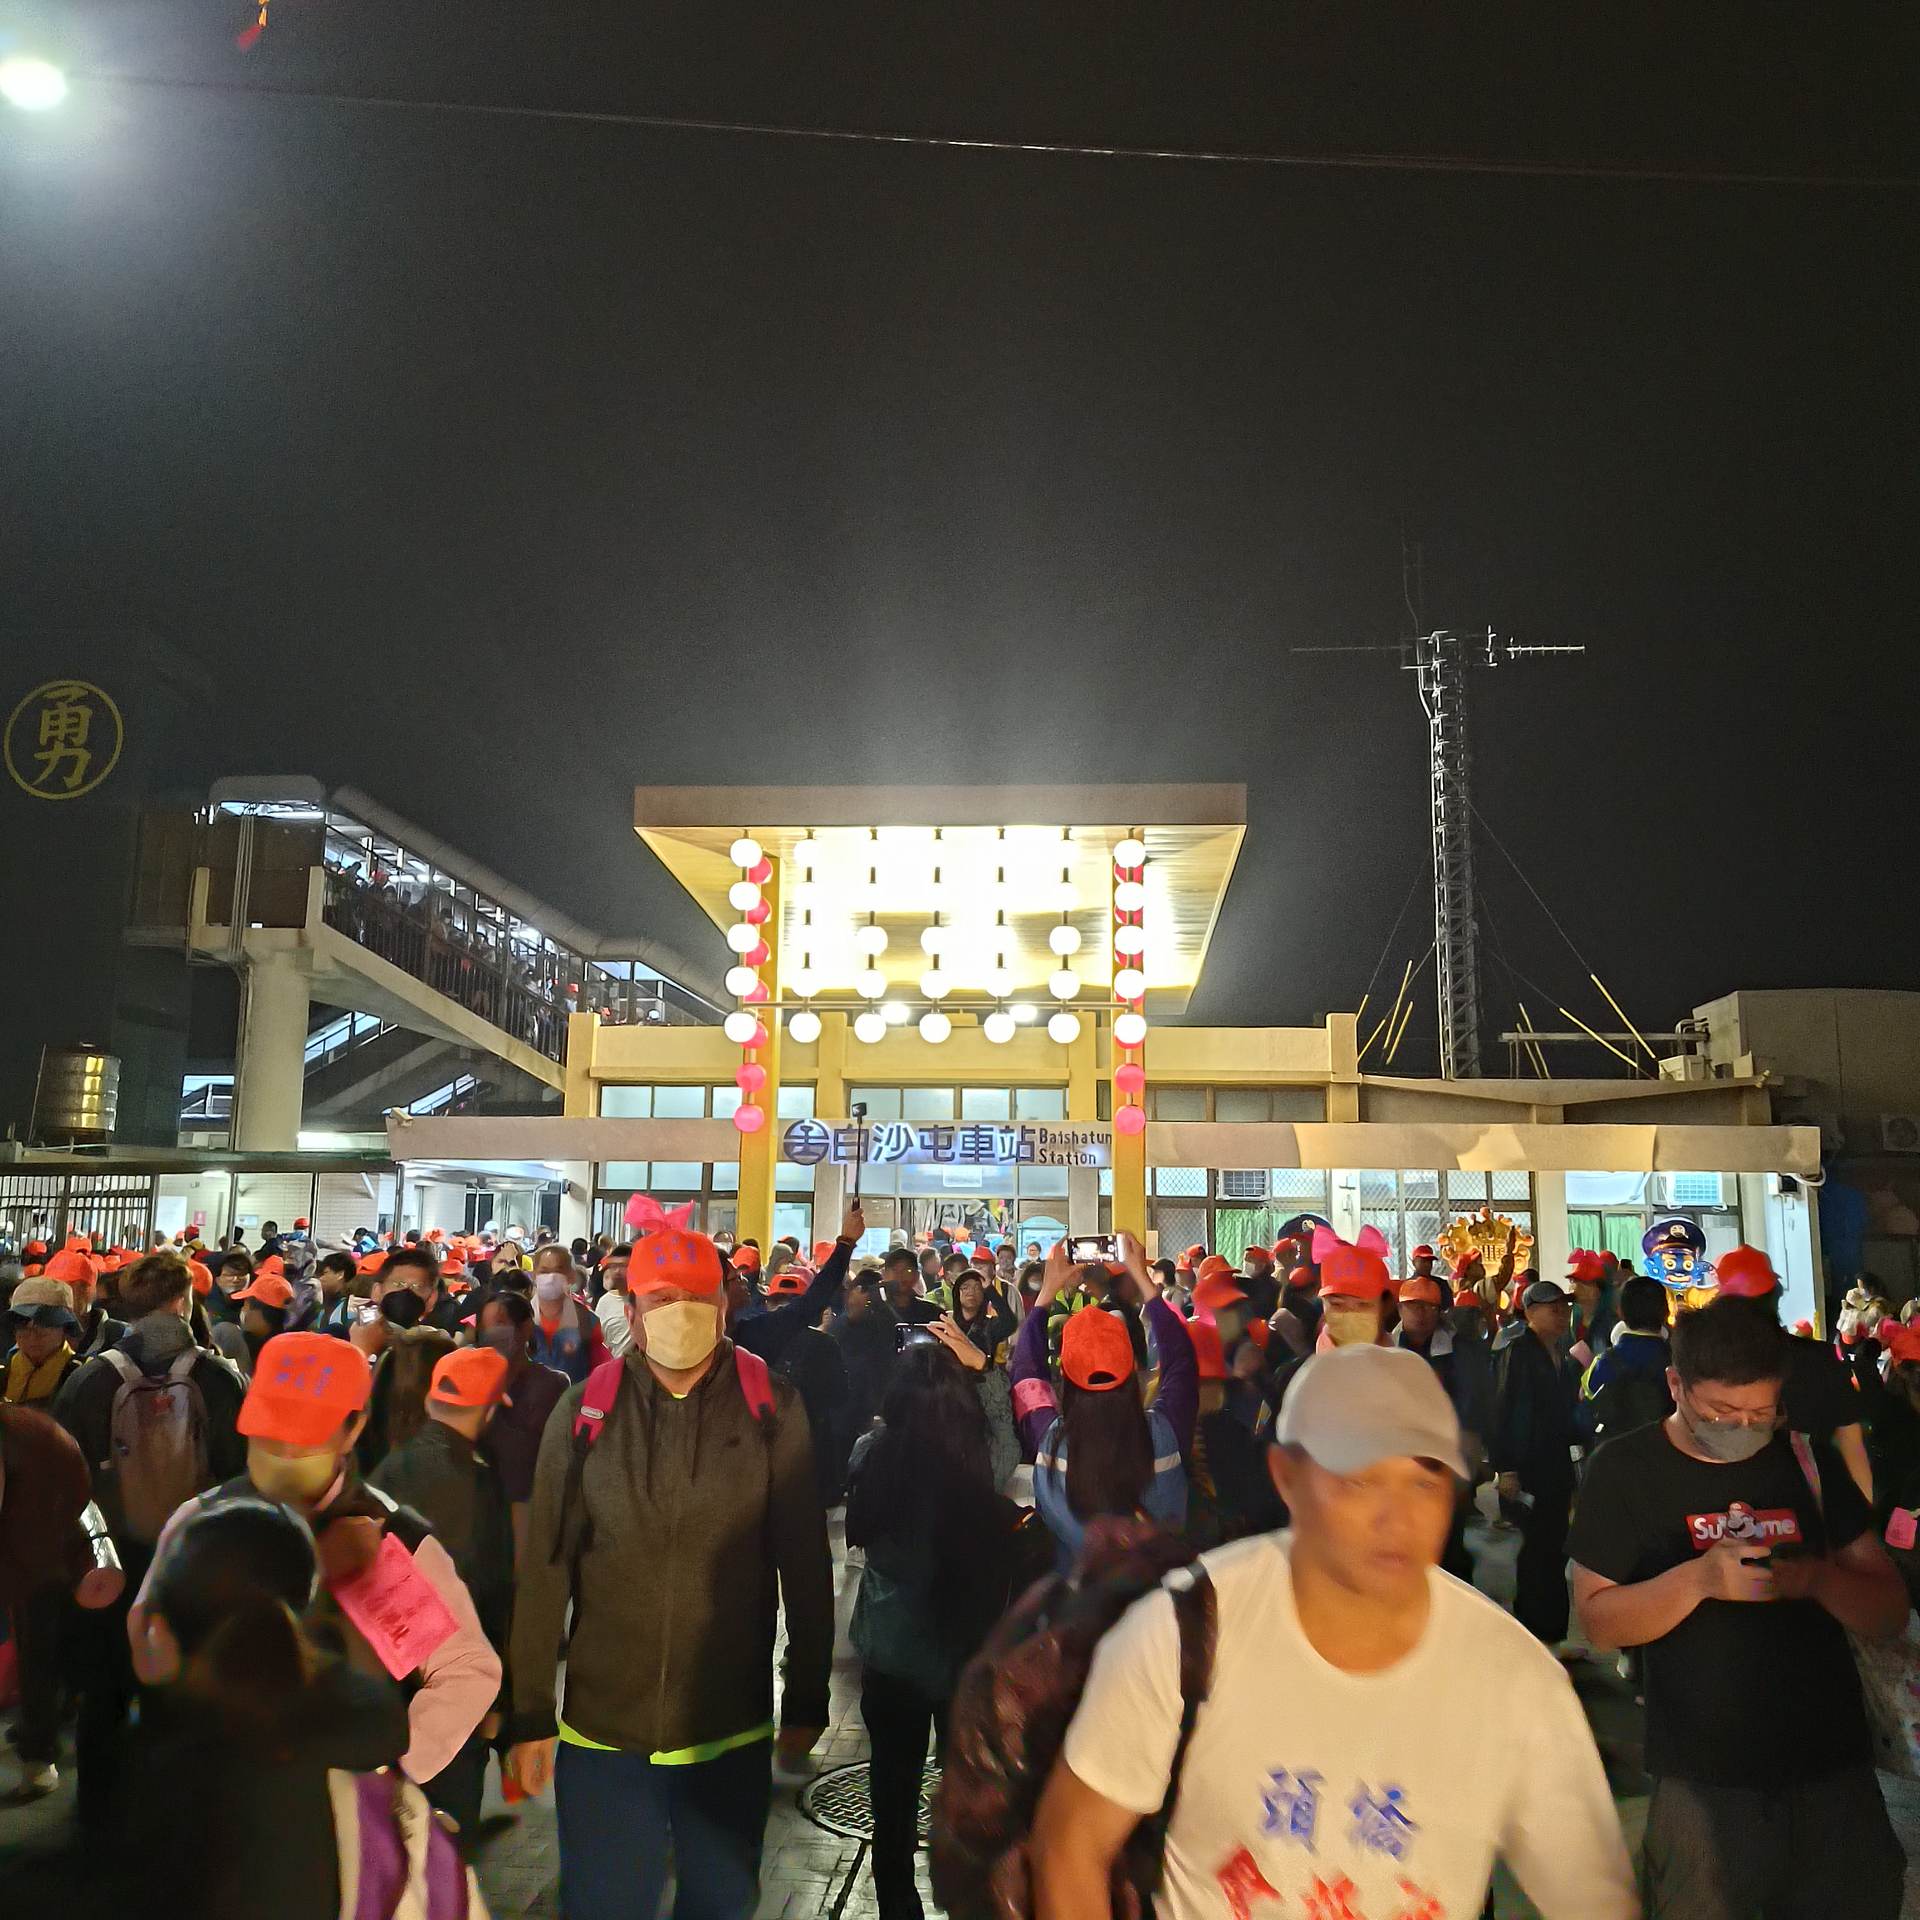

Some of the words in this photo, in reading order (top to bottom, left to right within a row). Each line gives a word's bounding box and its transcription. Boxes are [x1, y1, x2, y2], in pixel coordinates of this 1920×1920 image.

[34, 686, 93, 789] 勇
[833, 1123, 1036, 1163] 白沙屯車站
[1039, 1127, 1112, 1146] Baishatun
[1039, 1148, 1096, 1166] Station
[1693, 1517, 1796, 1540] Sume
